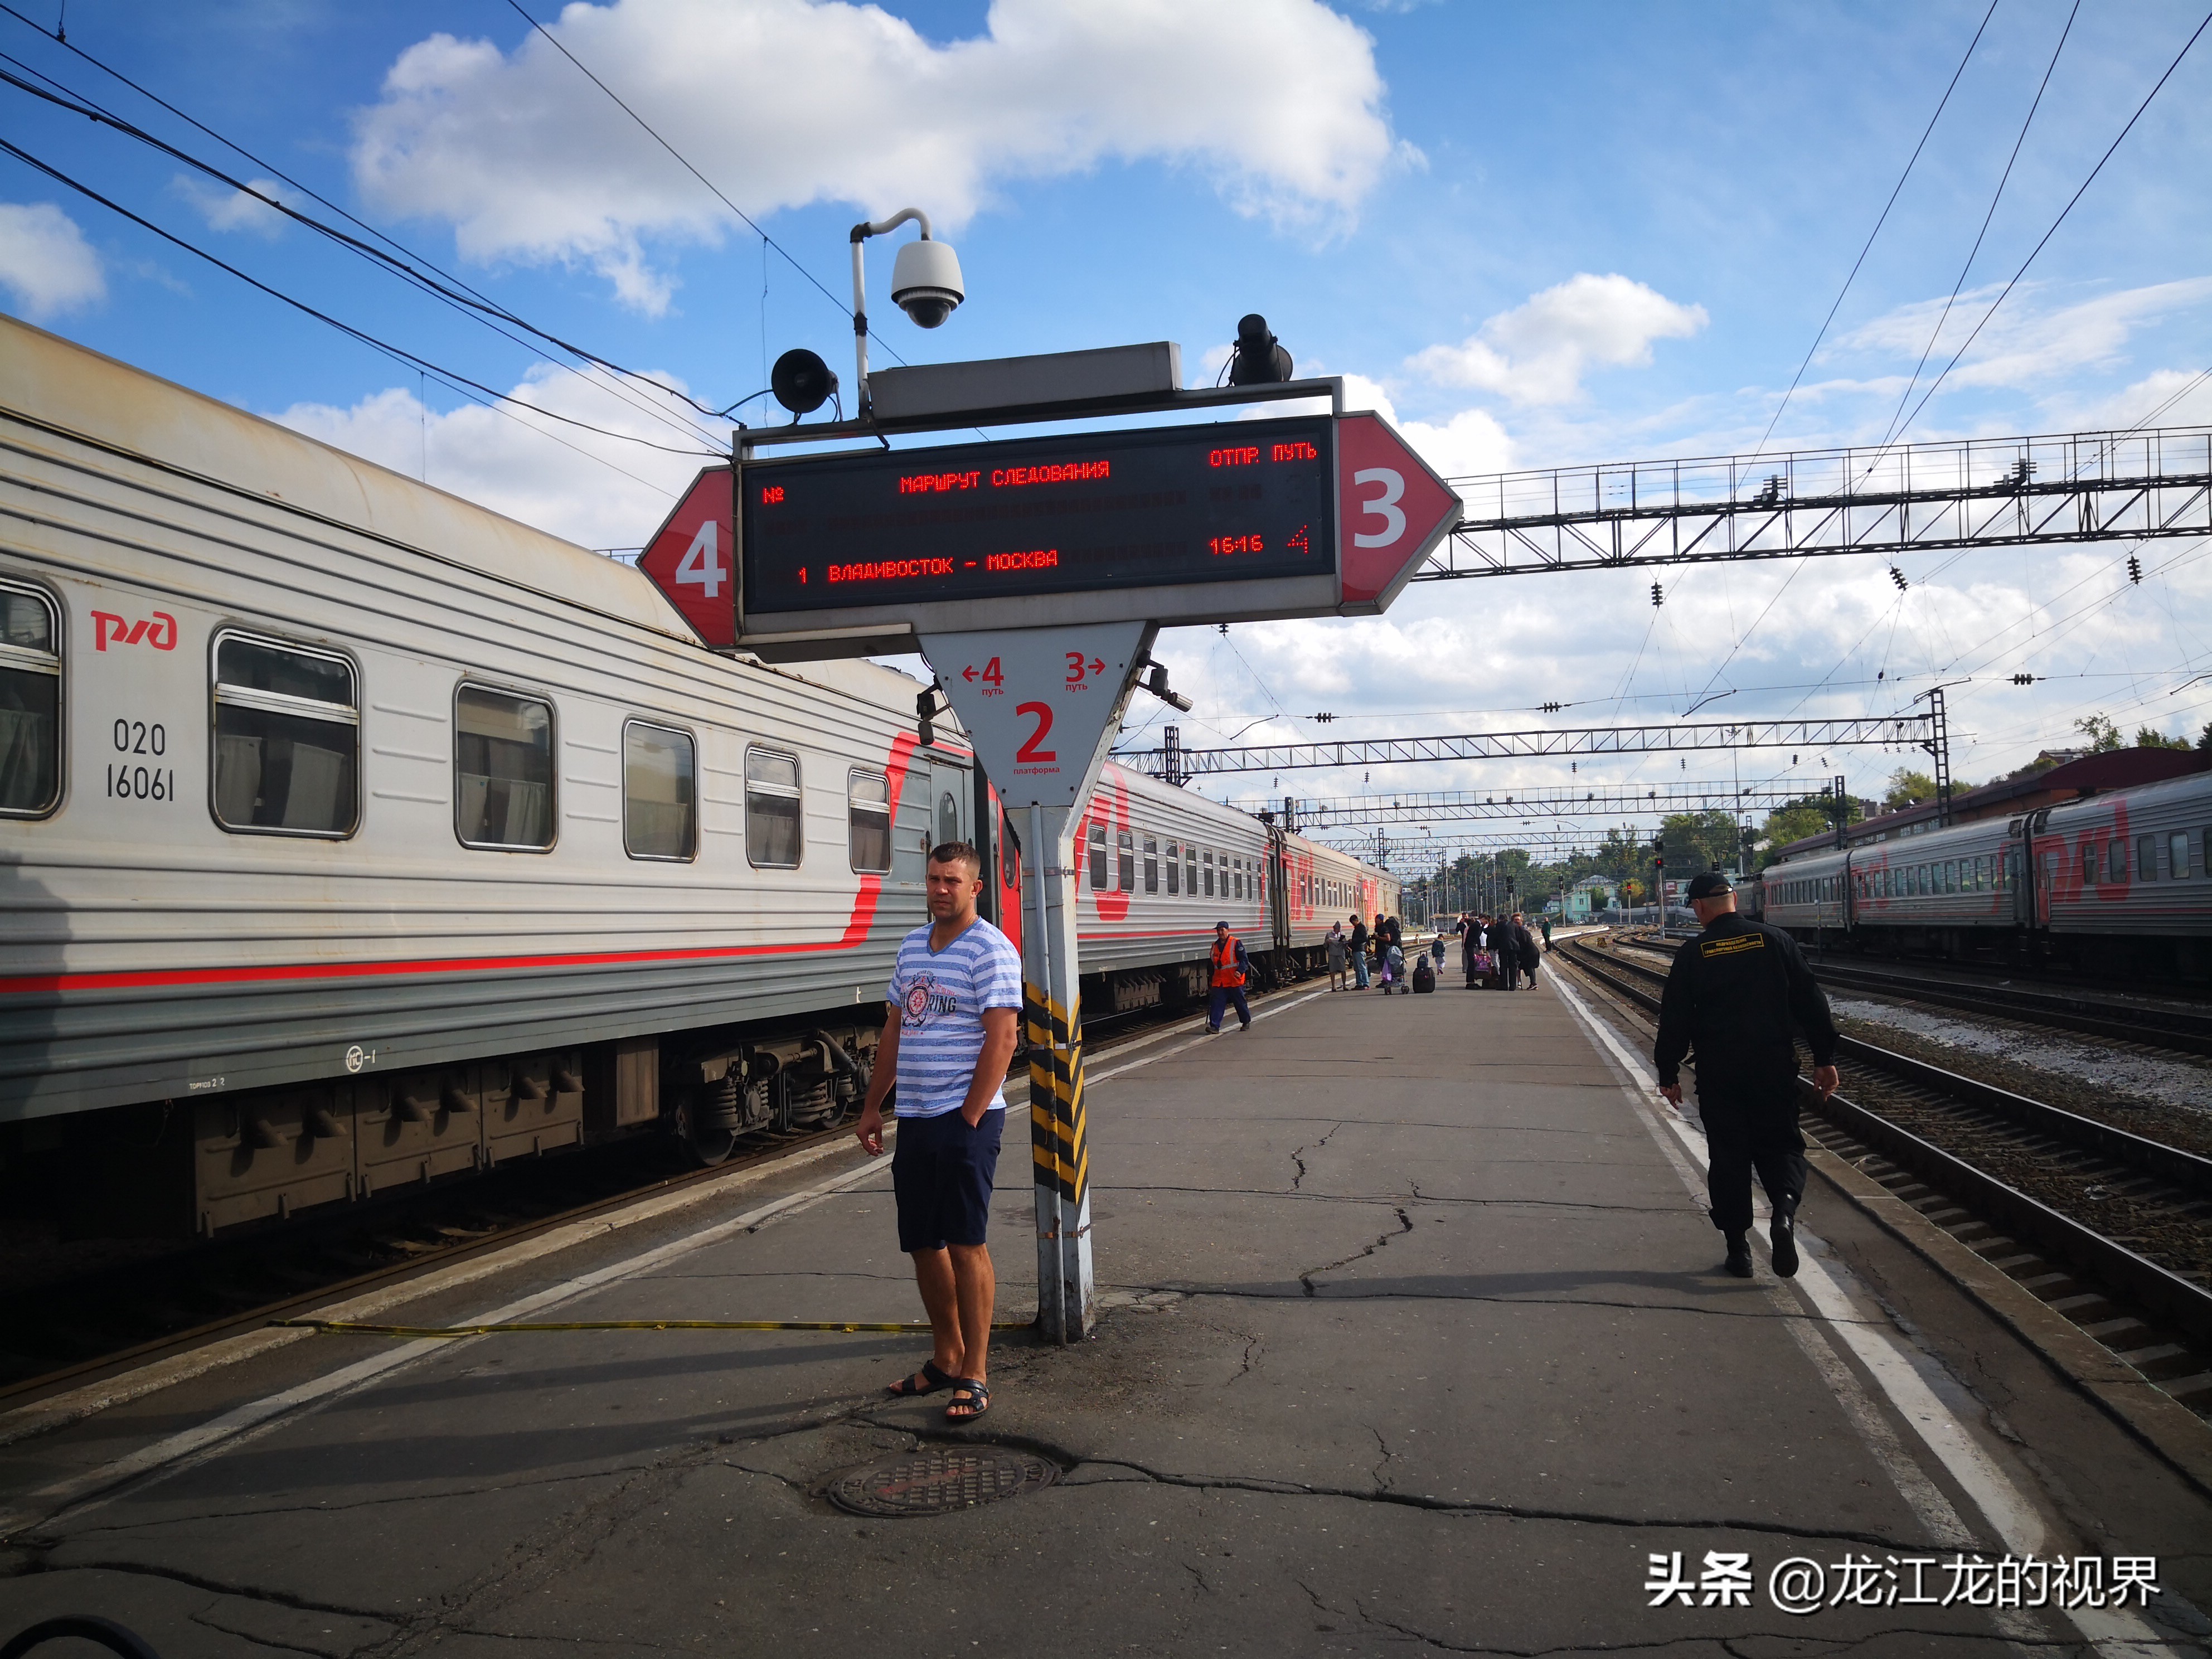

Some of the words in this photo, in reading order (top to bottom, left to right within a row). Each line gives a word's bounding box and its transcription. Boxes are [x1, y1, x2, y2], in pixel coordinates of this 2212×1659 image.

[1209, 446, 1260, 467] ОТПР.
[1272, 442, 1317, 463] ПУТЬ
[900, 471, 981, 494] МАРШРУТ
[992, 460, 1110, 487] СЛЕДОВАНИЯ
[763, 486, 785, 504] №
[1354, 467, 1406, 548] 3
[676, 521, 727, 598] 4
[798, 567, 807, 584] 1
[828, 557, 953, 583] ВЛАДИВОСТОК
[987, 549, 1058, 571] МОСКВА
[1209, 535, 1263, 555] 16:16
[1287, 525, 1308, 554] 4
[982, 657, 1004, 686] 4
[1065, 652, 1085, 683] 3
[982, 688, 1004, 697] путь
[1065, 683, 1088, 692] путь
[114, 719, 166, 756] 020
[1016, 701, 1056, 763] 2
[108, 764, 173, 802] 16061
[1013, 766, 1060, 775] платформа
